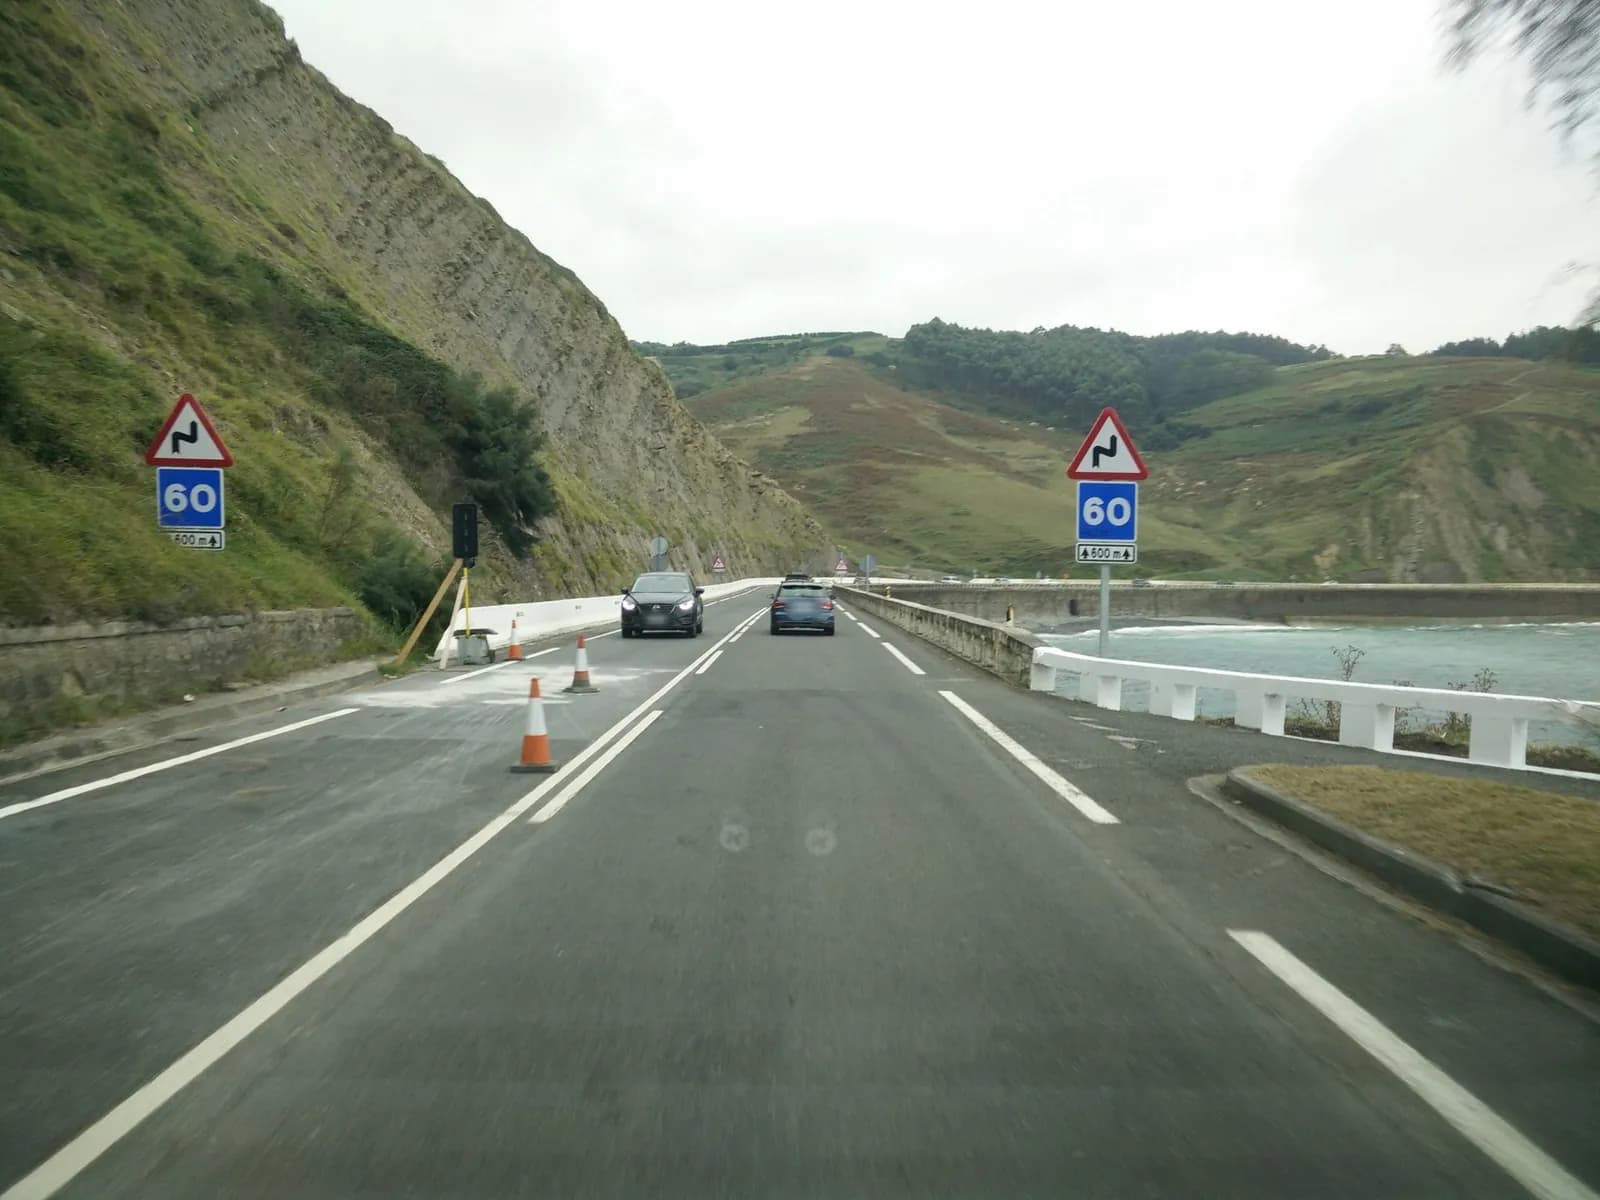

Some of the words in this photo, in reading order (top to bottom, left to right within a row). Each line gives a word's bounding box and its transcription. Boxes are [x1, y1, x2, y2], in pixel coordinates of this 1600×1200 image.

[164, 483, 217, 513] 60
[1083, 497, 1131, 526] 60
[1091, 548, 1110, 558] 600
[1113, 551, 1121, 559] m
